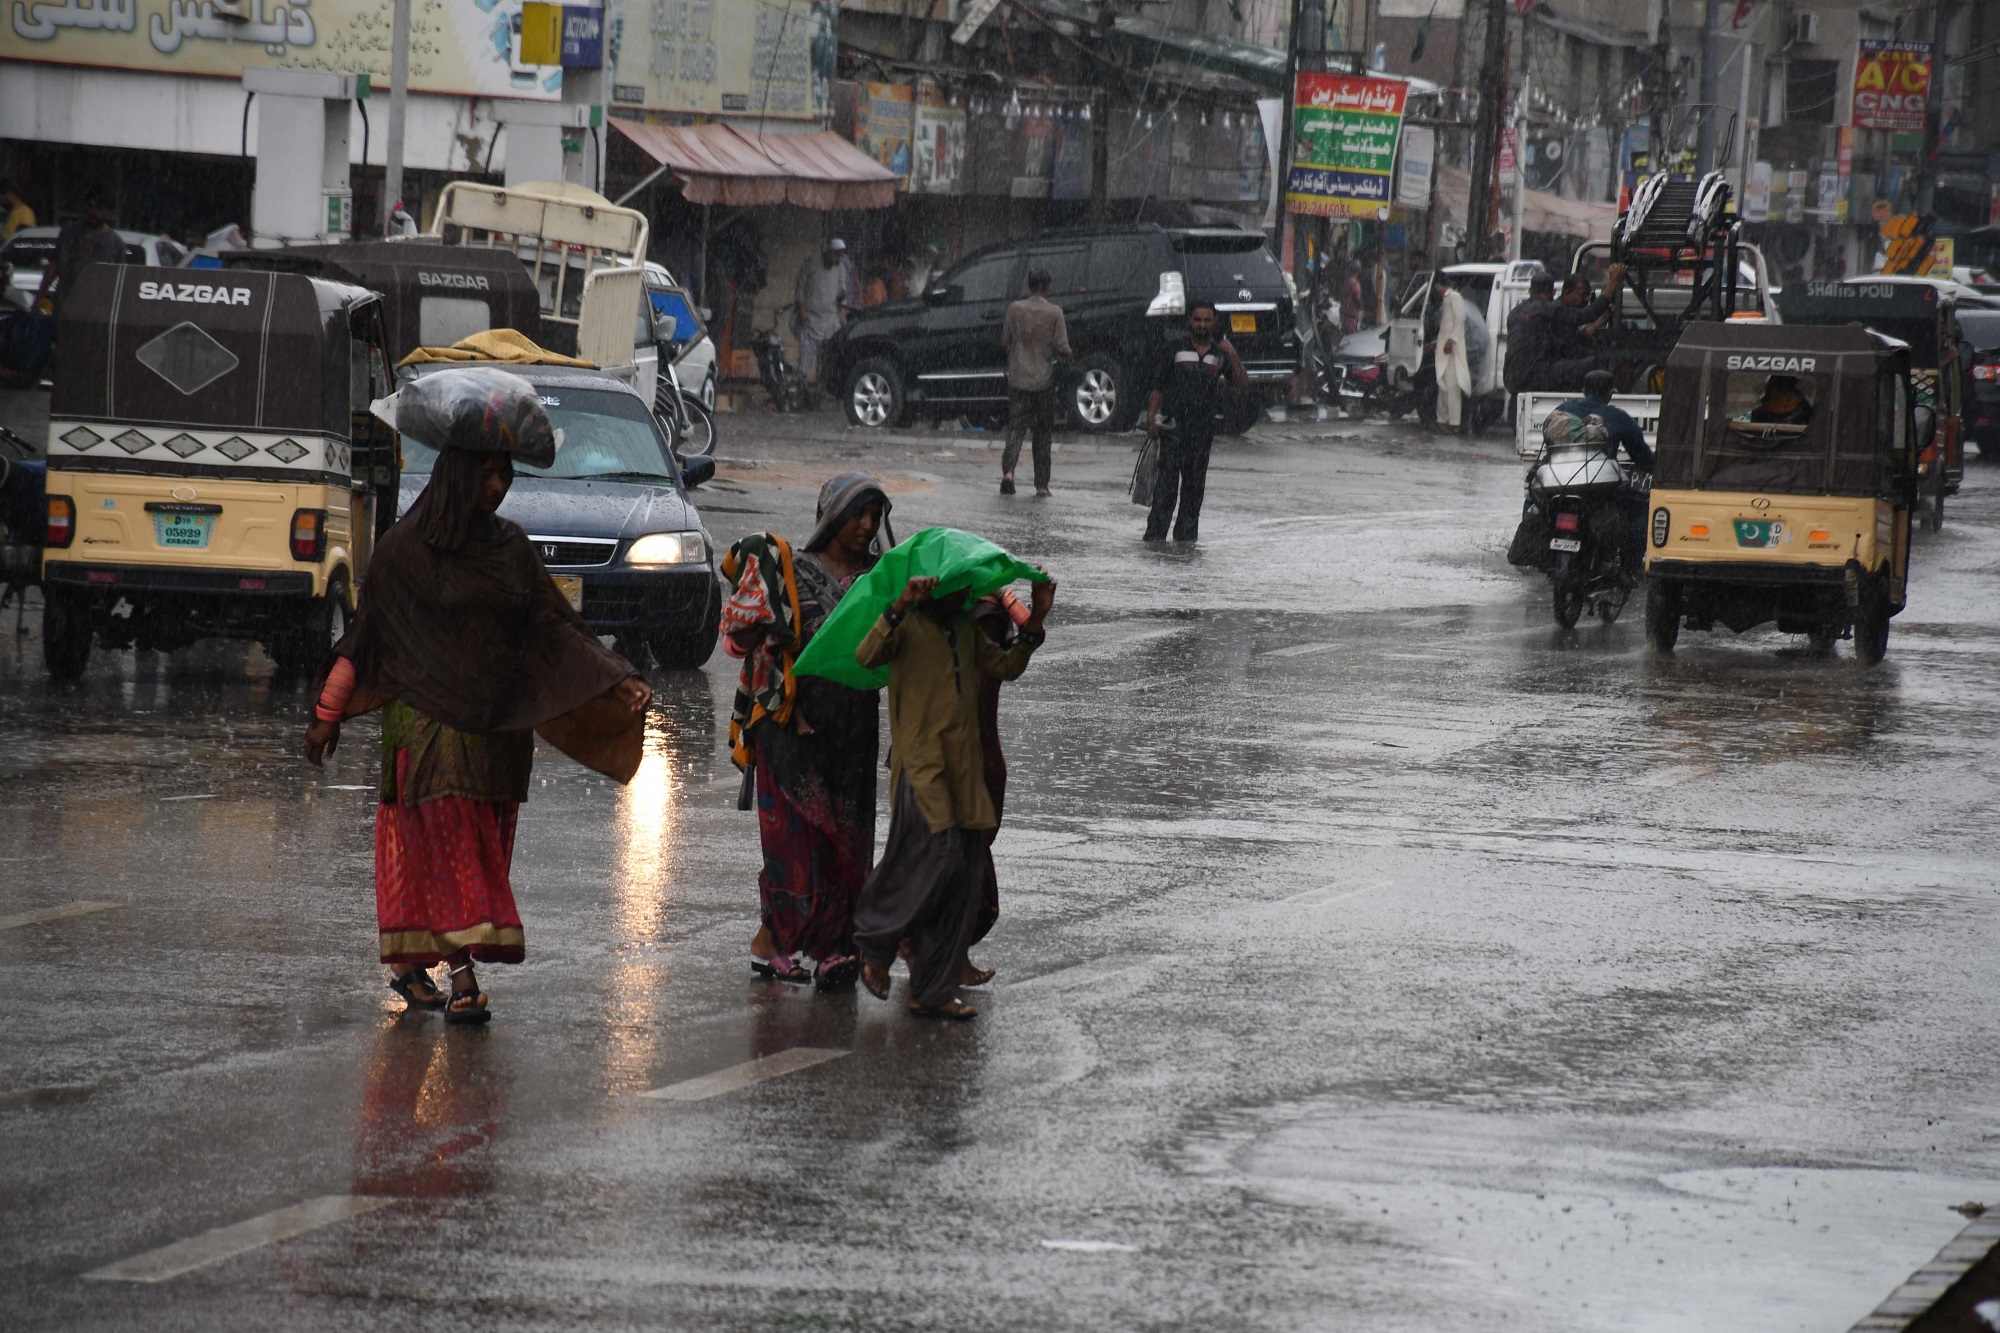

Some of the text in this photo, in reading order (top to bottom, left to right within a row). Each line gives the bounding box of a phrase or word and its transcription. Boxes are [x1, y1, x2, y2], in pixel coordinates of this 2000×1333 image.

[1856, 61, 1929, 93] A/C
[1855, 93, 1925, 112] CNG
[418, 272, 489, 290] SAZGAR
[139, 282, 251, 305] SAZGAR
[1727, 356, 1816, 372] SAZGAR
